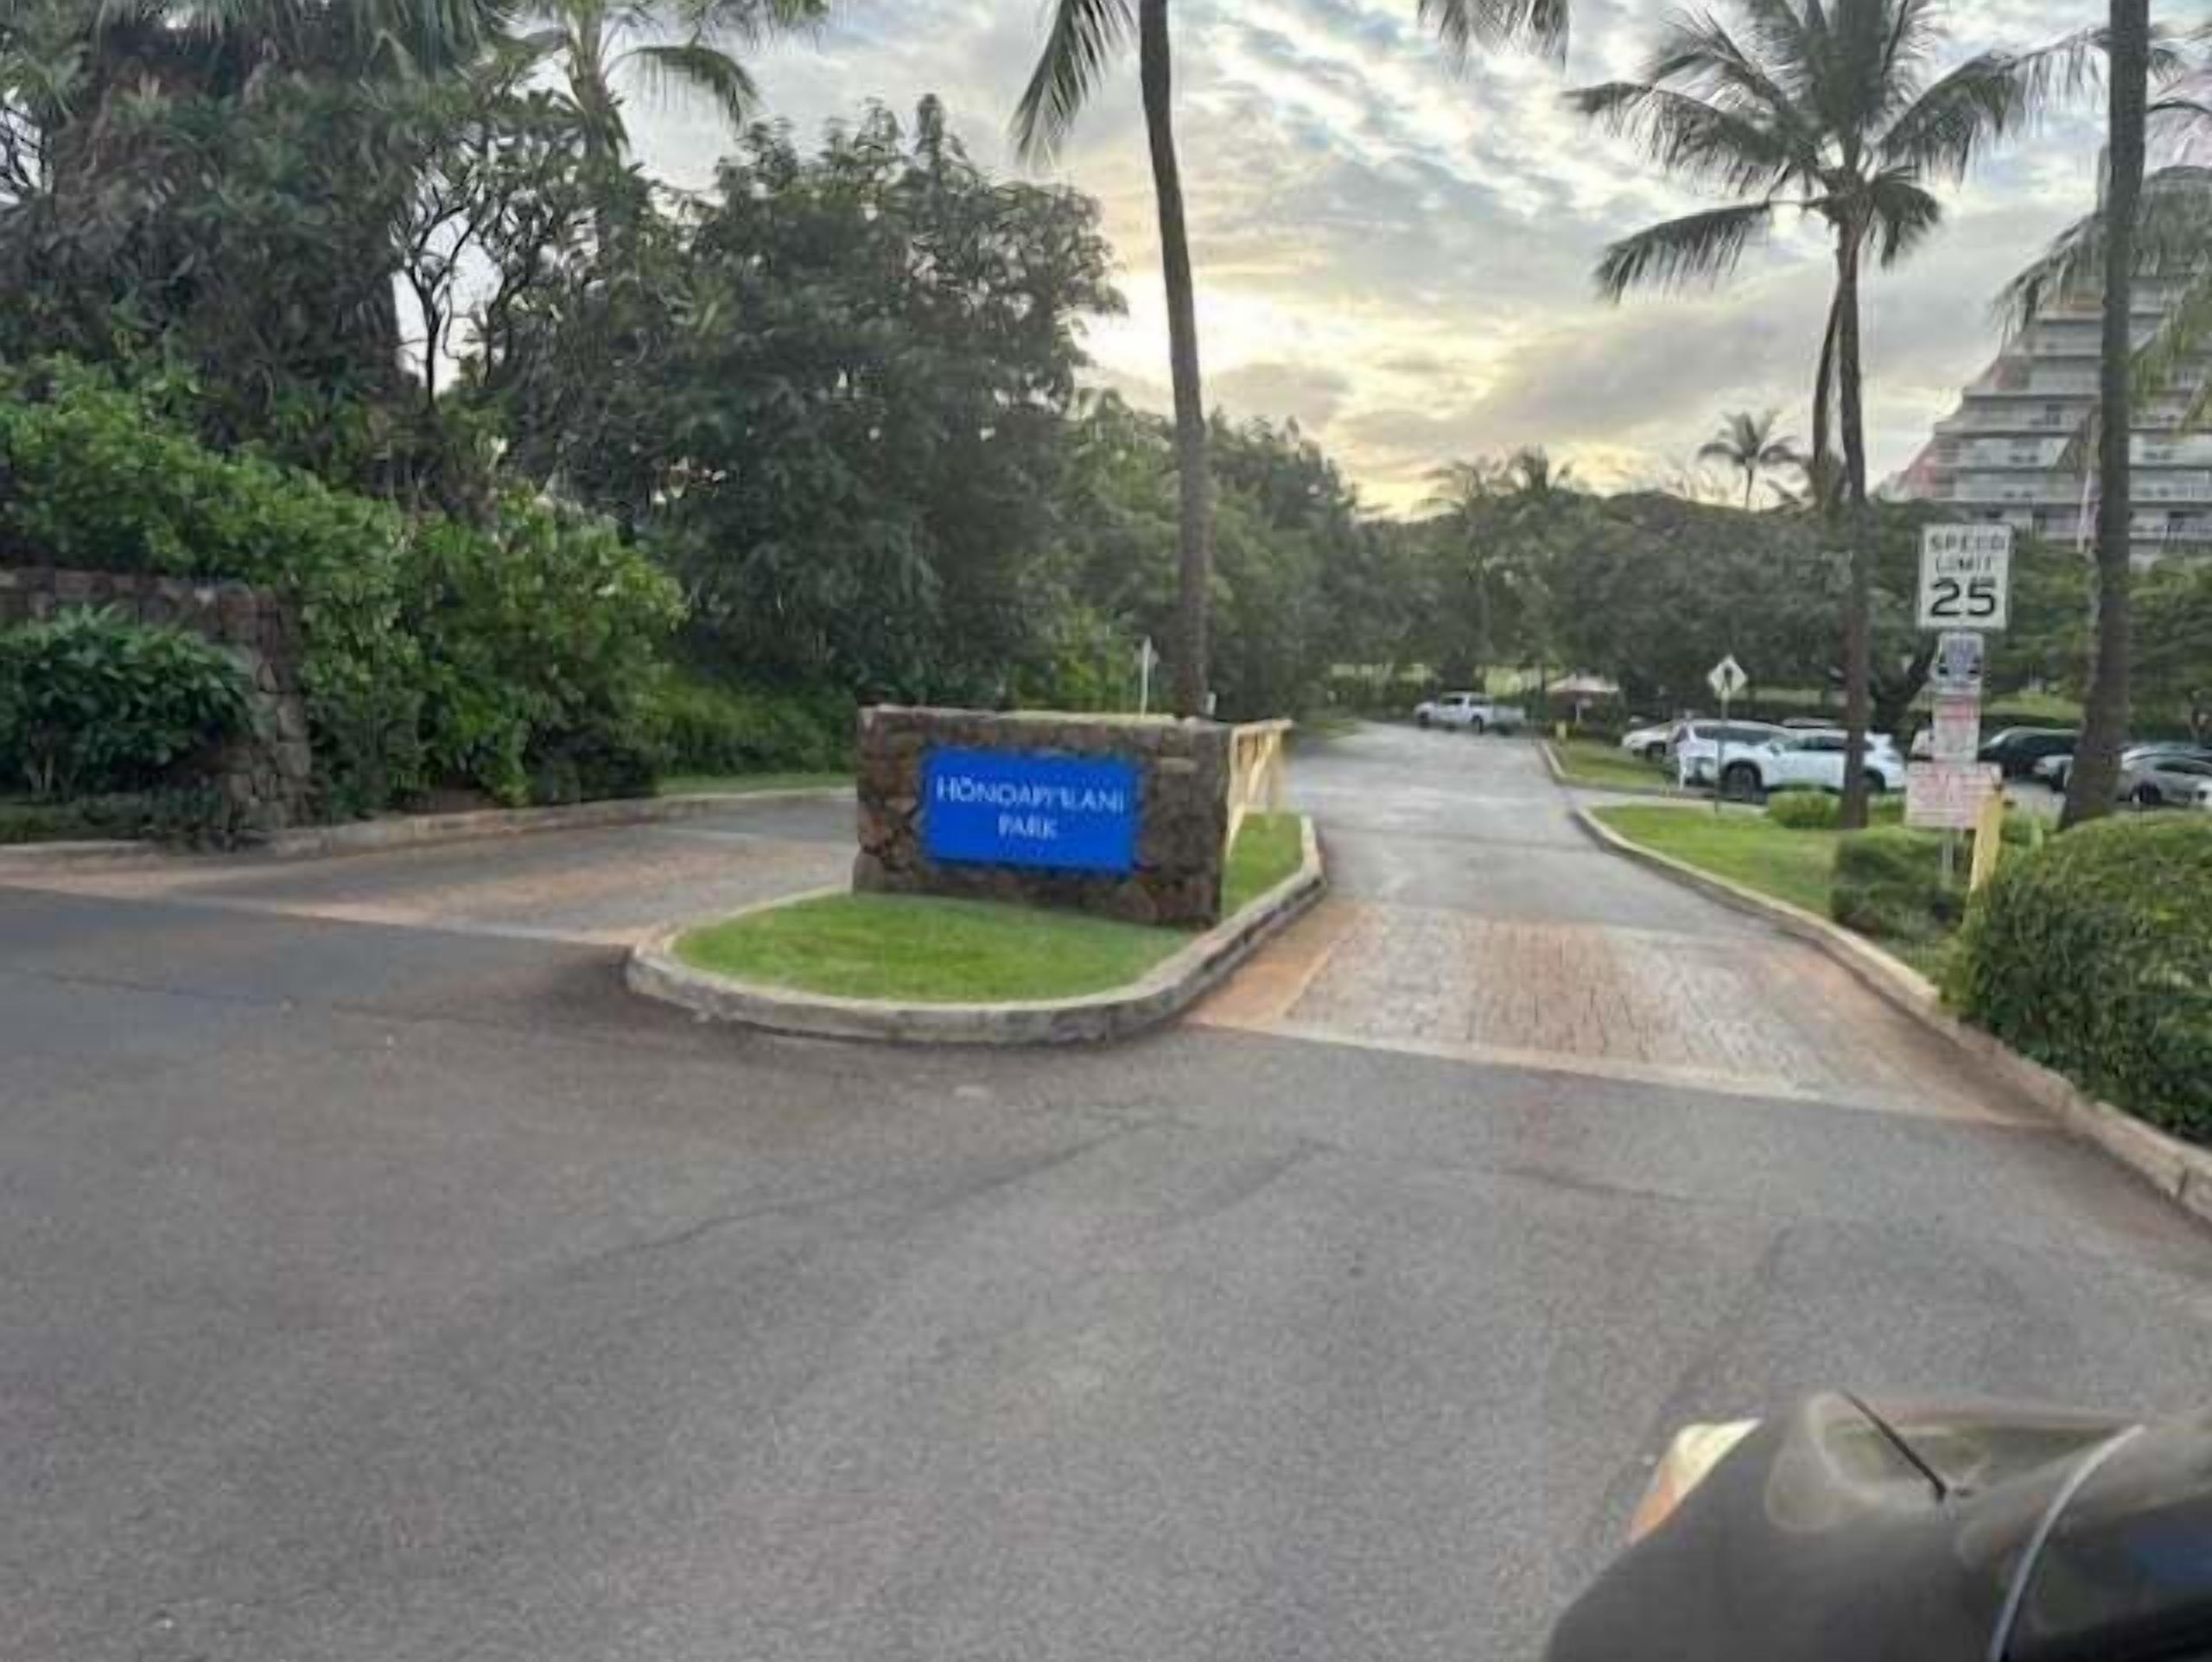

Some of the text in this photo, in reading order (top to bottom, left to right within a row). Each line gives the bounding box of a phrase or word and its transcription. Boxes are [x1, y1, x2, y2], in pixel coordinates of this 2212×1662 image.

[1930, 534, 2006, 550] SPEED
[1935, 555, 1993, 572] LIMIT
[1930, 577, 1996, 618] 25
[998, 815, 1058, 841] PARK
